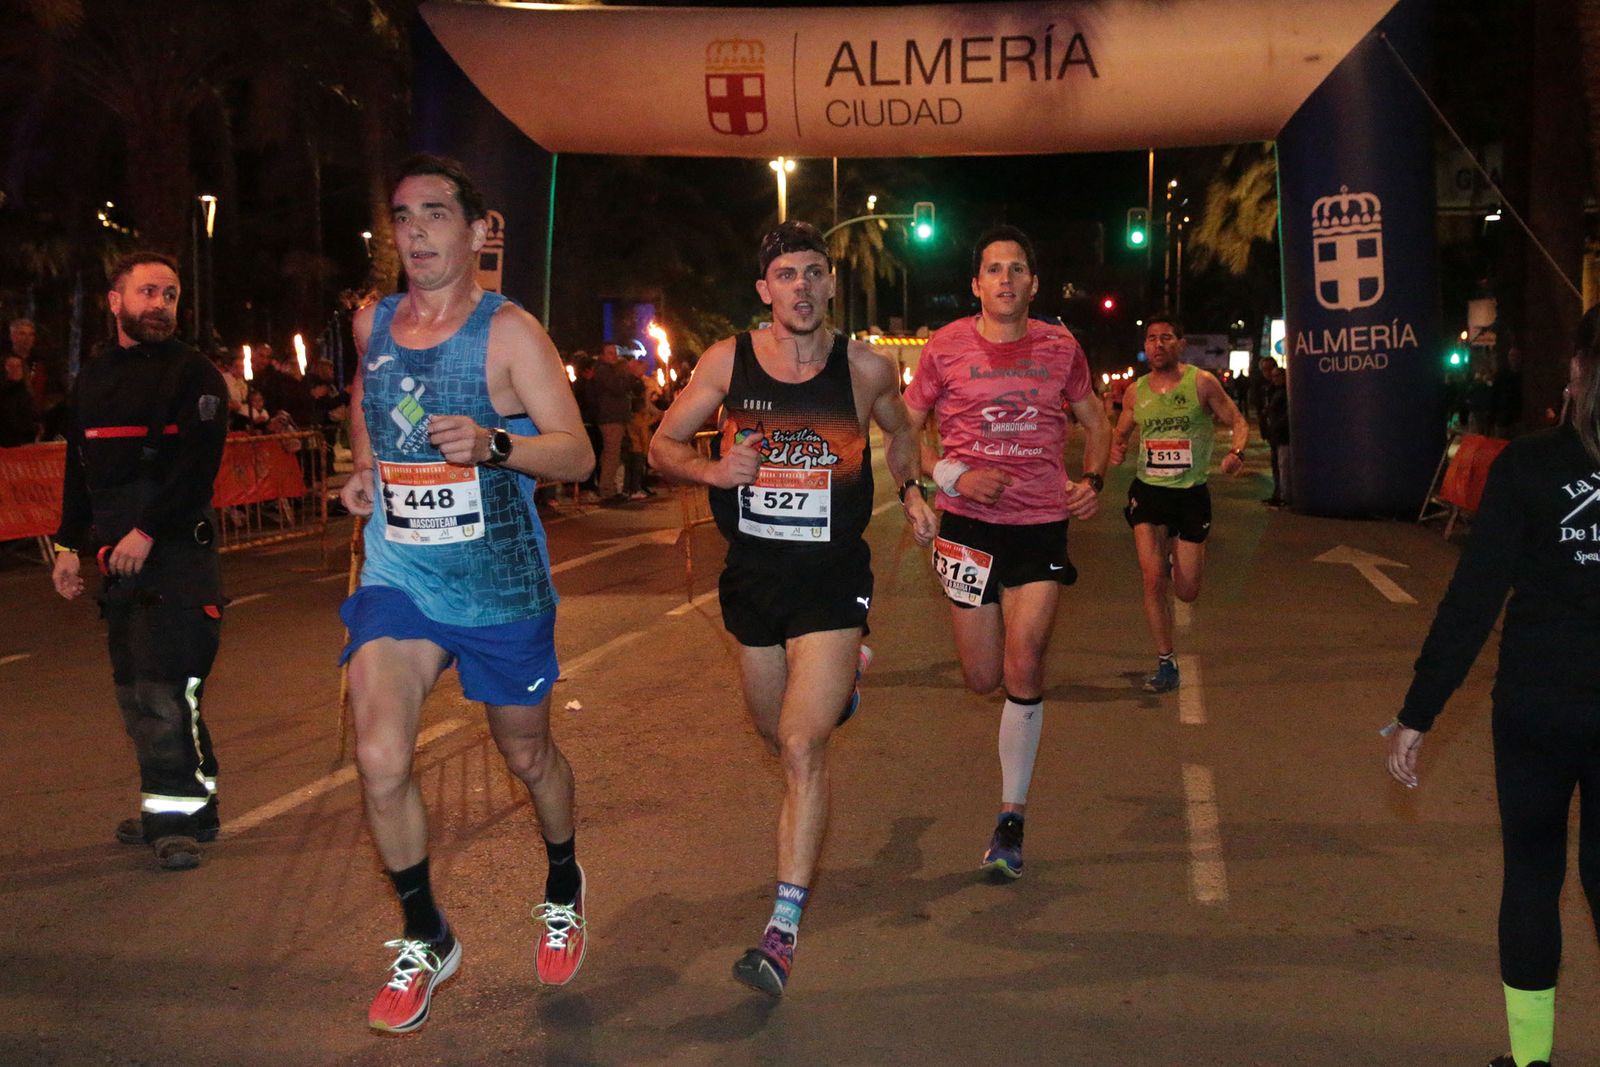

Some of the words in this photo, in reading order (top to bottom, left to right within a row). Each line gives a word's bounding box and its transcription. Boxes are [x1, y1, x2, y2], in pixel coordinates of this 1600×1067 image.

[824, 24, 1099, 86] ALMERÍA
[825, 97, 964, 128] CIUDAD
[1295, 318, 1418, 355] ALMERÍA
[1318, 353, 1389, 373] CIUDAD
[743, 399, 773, 411] GOBIK
[773, 428, 822, 443] triatlón
[971, 440, 981, 452] A
[1007, 442, 1044, 457] Marcos
[1157, 451, 1181, 461] 513
[404, 488, 455, 510] 448
[1561, 479, 1594, 500] La
[763, 491, 809, 510] 527
[409, 516, 458, 529] MASCOTEAM
[1559, 526, 1586, 543] De
[1574, 549, 1600, 565] Spea
[940, 556, 979, 585] 318
